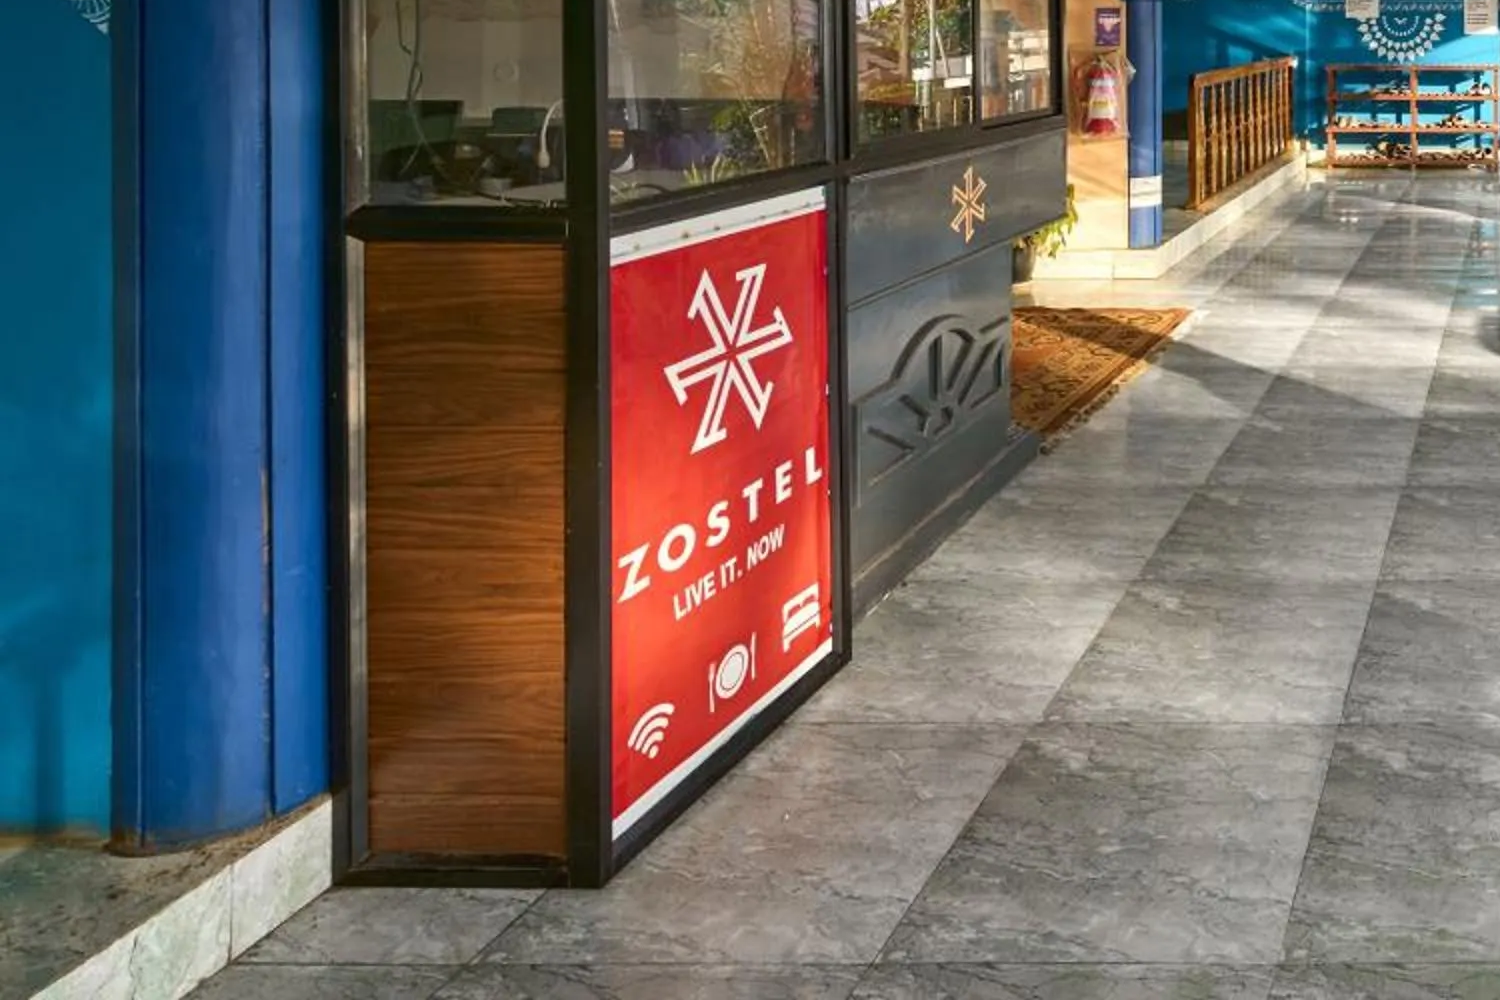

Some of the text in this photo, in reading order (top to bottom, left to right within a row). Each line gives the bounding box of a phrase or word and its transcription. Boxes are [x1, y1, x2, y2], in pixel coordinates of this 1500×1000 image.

[617, 446, 823, 604] ZOSTEL
[672, 523, 785, 621] LIVE IT. NOW
